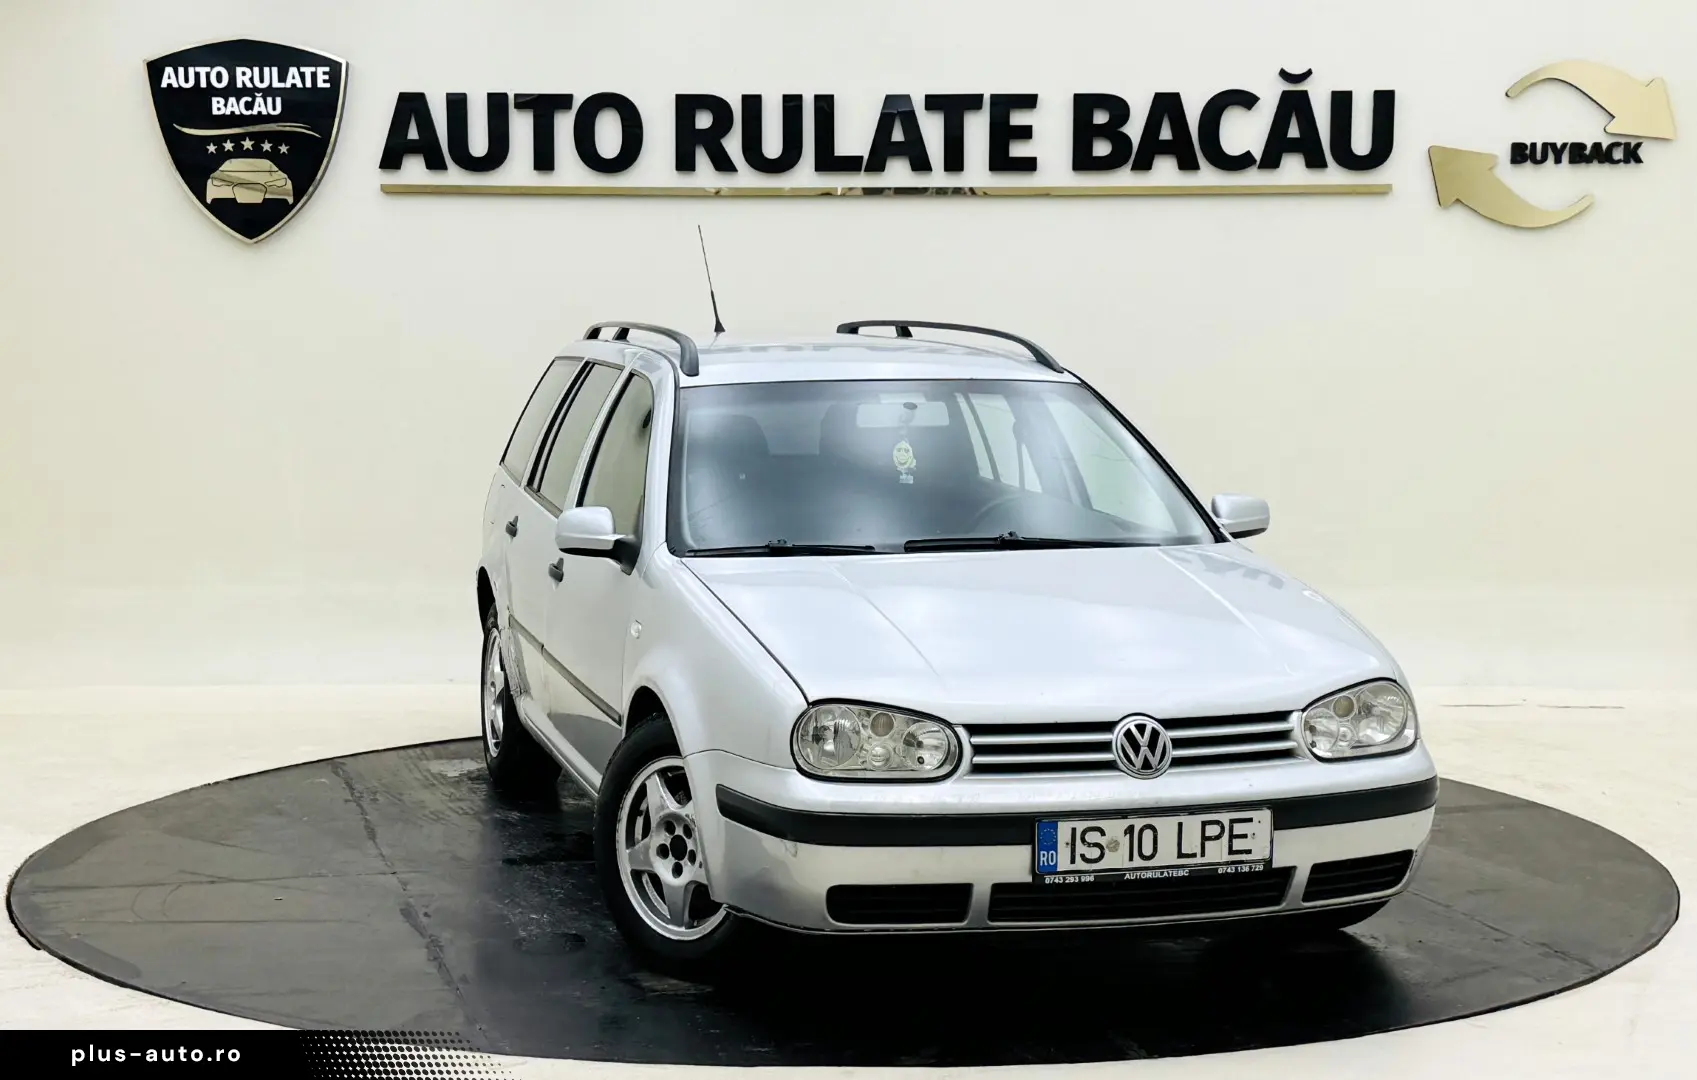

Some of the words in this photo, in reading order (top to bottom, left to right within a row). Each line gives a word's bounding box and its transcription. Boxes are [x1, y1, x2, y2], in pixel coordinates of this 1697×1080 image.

[160, 66, 229, 89] AUTO
[235, 66, 331, 89] RULATE
[211, 92, 282, 116] BACĂU
[378, 91, 644, 173] AUTO
[674, 93, 1039, 173] RULATE
[1071, 67, 1395, 172] BACĂU
[1510, 141, 1644, 165] BUYBACK
[1069, 826, 1107, 865] IS
[1123, 823, 1159, 862] 10
[1176, 817, 1254, 860] LPE
[1039, 850, 1057, 867] RO
[1251, 864, 1264, 872] 729
[1044, 876, 1064, 884] 0743
